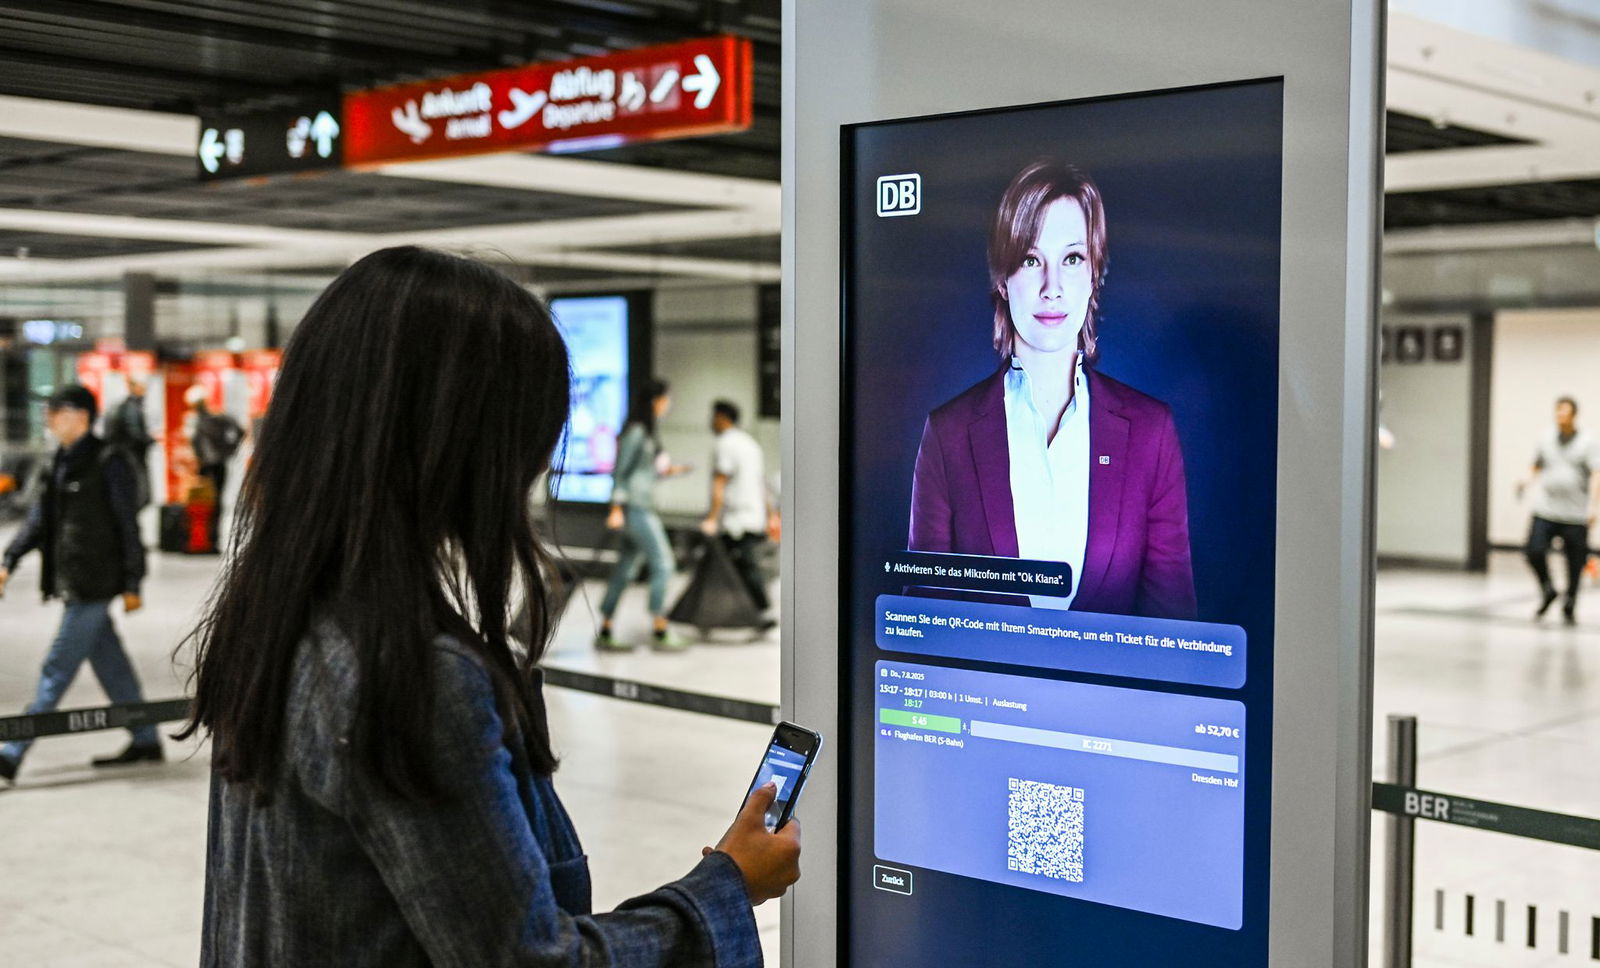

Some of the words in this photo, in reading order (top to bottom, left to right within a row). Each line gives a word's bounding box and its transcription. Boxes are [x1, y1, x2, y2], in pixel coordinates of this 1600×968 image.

[882, 181, 916, 210] DB
[894, 563, 932, 575] Aktivieren
[934, 566, 946, 576] Sie
[948, 566, 962, 577] das
[964, 569, 999, 581] Mikrofon
[1002, 571, 1016, 581] mit
[1017, 573, 1033, 583] "Ok
[885, 627, 894, 635] zu
[896, 627, 924, 638] kaufen.
[885, 611, 917, 623] Scannen
[918, 614, 930, 625] Sie
[932, 616, 946, 626] den
[948, 617, 984, 630] QR-Code
[986, 621, 1000, 632] mit
[1027, 624, 1081, 640] Smartphone,
[1084, 632, 1097, 640] um
[1099, 633, 1113, 642] ein
[1115, 632, 1143, 645] Ticket
[1144, 635, 1158, 647] für
[1160, 637, 1175, 648] die
[1177, 639, 1232, 656] Verbindung
[880, 684, 898, 694] 15:17
[904, 687, 922, 697] 18:17
[929, 690, 947, 700] 03:00
[948, 692, 952, 700] h
[959, 694, 964, 702] 1
[993, 698, 1027, 712] Auslastung
[904, 698, 922, 708] 18:17
[912, 716, 917, 725] S
[894, 730, 923, 741] Flughafen
[923, 734, 937, 744] BER
[937, 736, 964, 749] (S-Bahn)
[1194, 724, 1206, 734] ab
[1207, 725, 1231, 737] 52,70
[1232, 728, 1239, 738] €
[1192, 773, 1222, 786] Dresden
[1224, 778, 1239, 788] Hbf
[1405, 792, 1449, 820] BER
